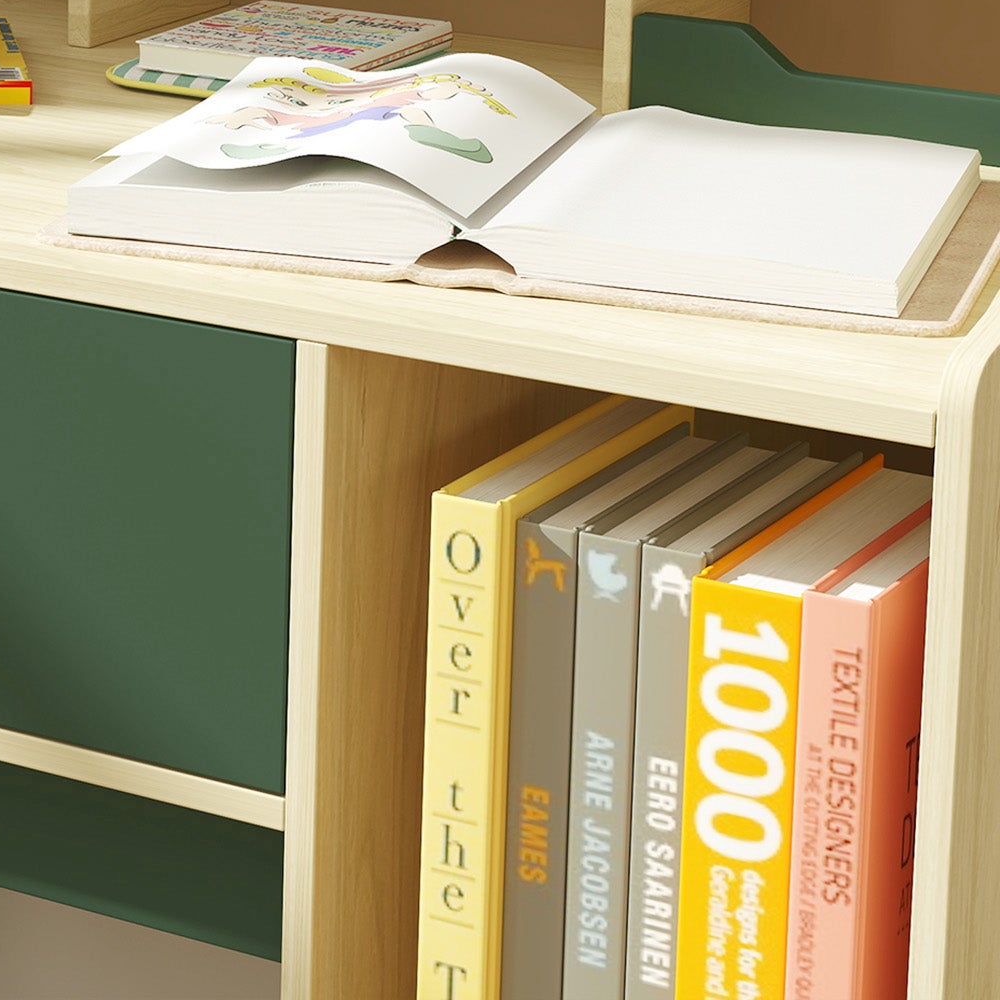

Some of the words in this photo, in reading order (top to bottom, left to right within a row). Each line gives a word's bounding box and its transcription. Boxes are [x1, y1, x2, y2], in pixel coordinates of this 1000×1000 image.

[445, 530, 482, 715] Over
[694, 612, 790, 863] 1000
[830, 648, 863, 751] TEXTILE
[582, 730, 615, 812] ARNE
[645, 755, 679, 835] EERO
[804, 768, 821, 795] THE
[441, 780, 467, 912] the
[517, 784, 550, 885] EAMES
[801, 797, 821, 858] CUTTING
[821, 756, 857, 907] DESIGNERS
[576, 817, 612, 969] JACOBSEN
[639, 840, 676, 988] SAARINEN
[706, 865, 736, 956] Geraldine
[734, 868, 765, 947] designs
[704, 956, 730, 997] and
[737, 948, 763, 979] for
